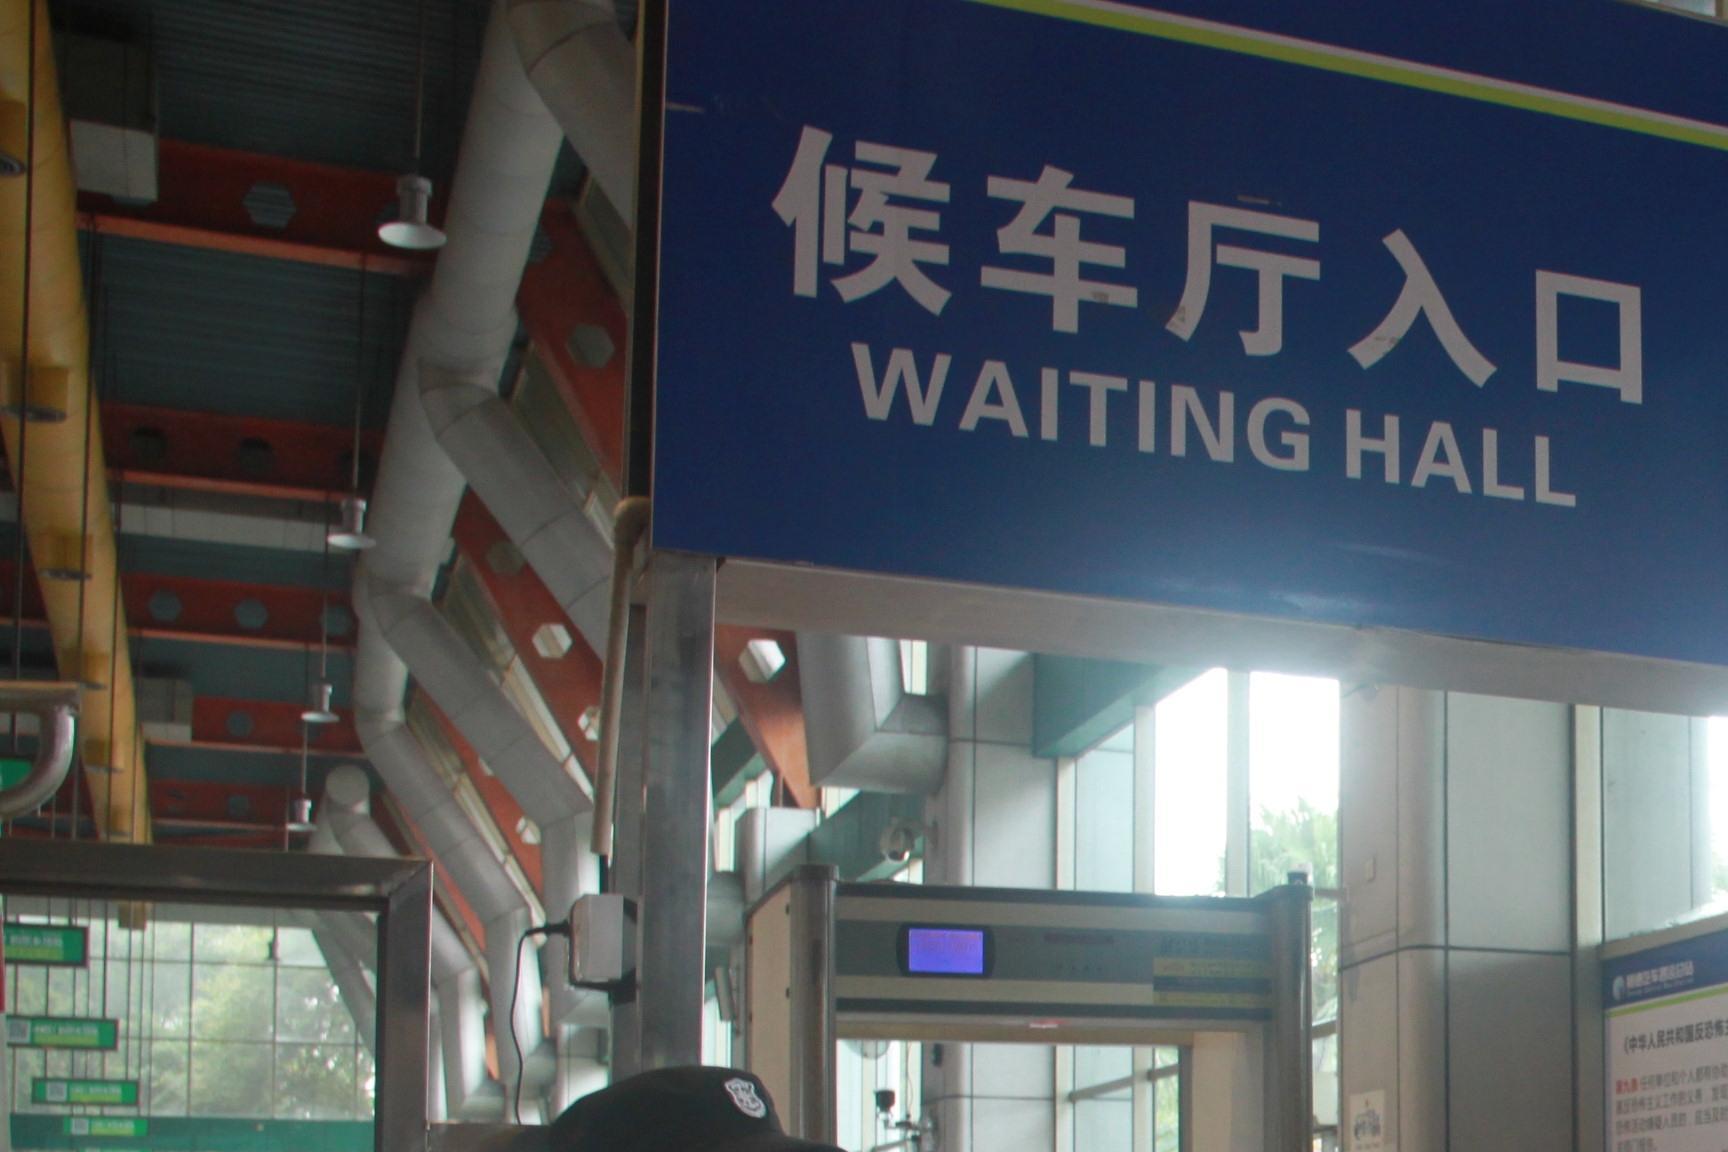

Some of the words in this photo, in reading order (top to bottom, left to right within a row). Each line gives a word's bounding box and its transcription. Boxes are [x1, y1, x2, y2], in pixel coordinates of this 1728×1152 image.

[772, 125, 1642, 404] 候车厅入口
[850, 342, 1311, 472] WAITING
[1345, 409, 1576, 508] HALL
